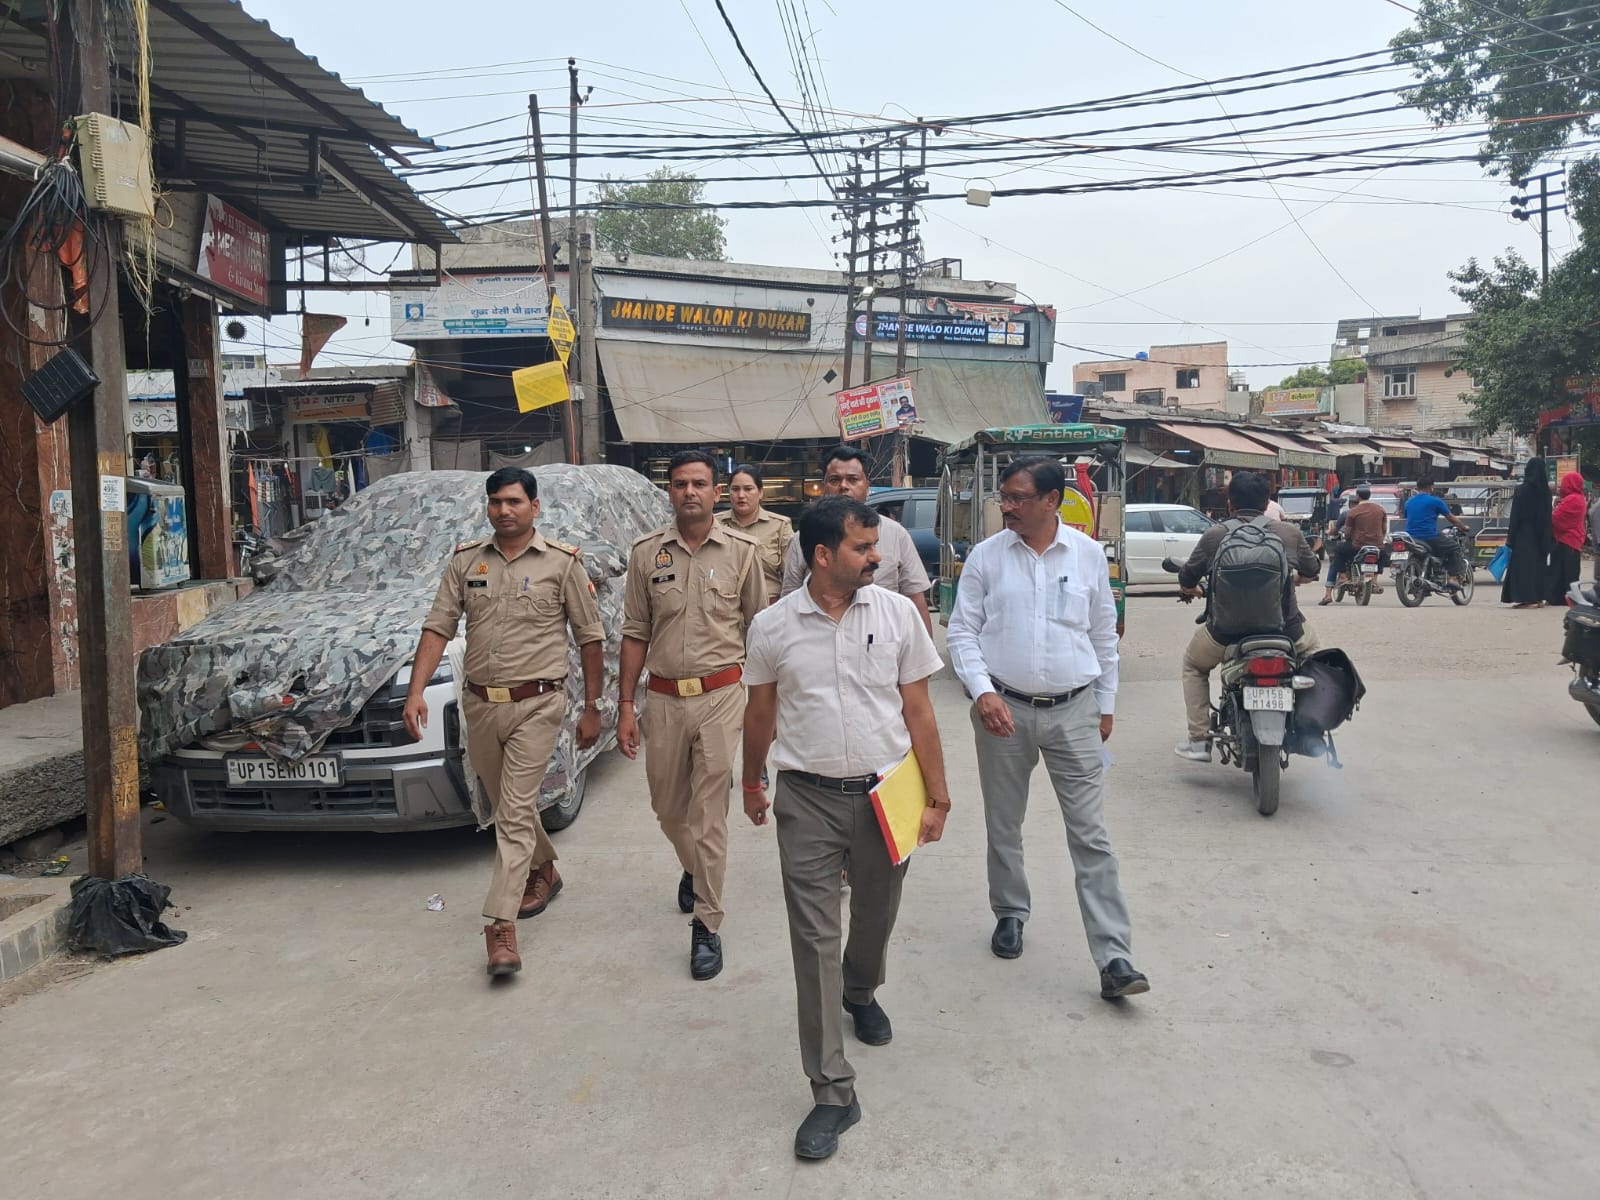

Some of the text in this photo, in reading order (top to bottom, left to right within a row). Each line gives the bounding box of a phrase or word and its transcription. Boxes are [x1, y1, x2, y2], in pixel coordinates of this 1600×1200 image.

[611, 301, 806, 331] JHANDE WALON KI DUKAN
[915, 323, 942, 334] WALO
[943, 325, 953, 335] KI
[953, 326, 986, 336] DUKAN
[1020, 429, 1091, 440] Panther
